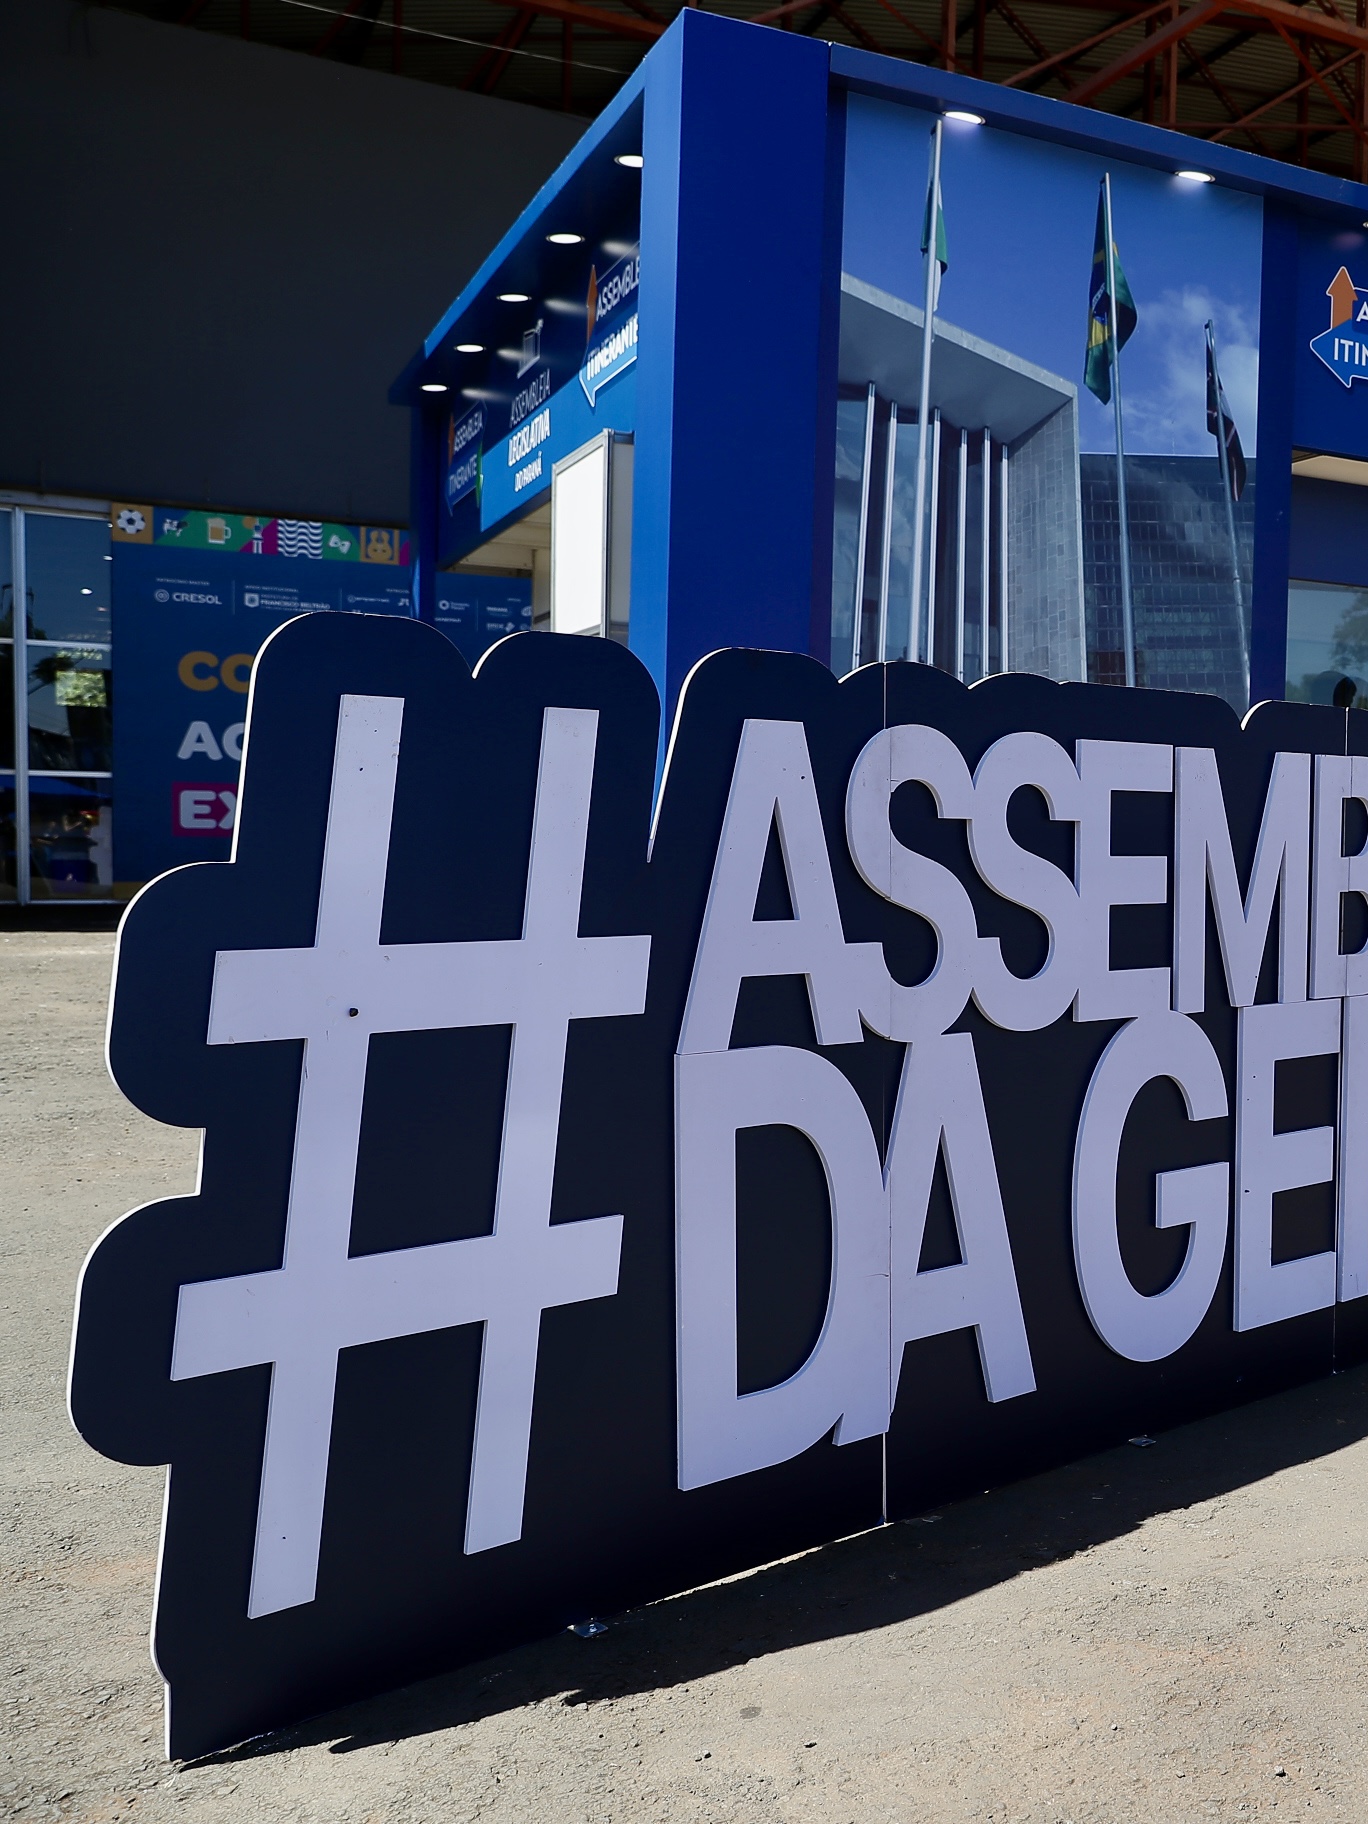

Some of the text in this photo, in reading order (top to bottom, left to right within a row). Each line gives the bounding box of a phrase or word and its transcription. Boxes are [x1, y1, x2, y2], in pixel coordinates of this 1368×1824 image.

[596, 255, 640, 321] ASSEMBLE
[509, 368, 551, 429] ASSEMBLEIA
[508, 407, 551, 467] LEGISLATIVA
[172, 592, 222, 605] CRESOL
[673, 1032, 1037, 1491] DA
